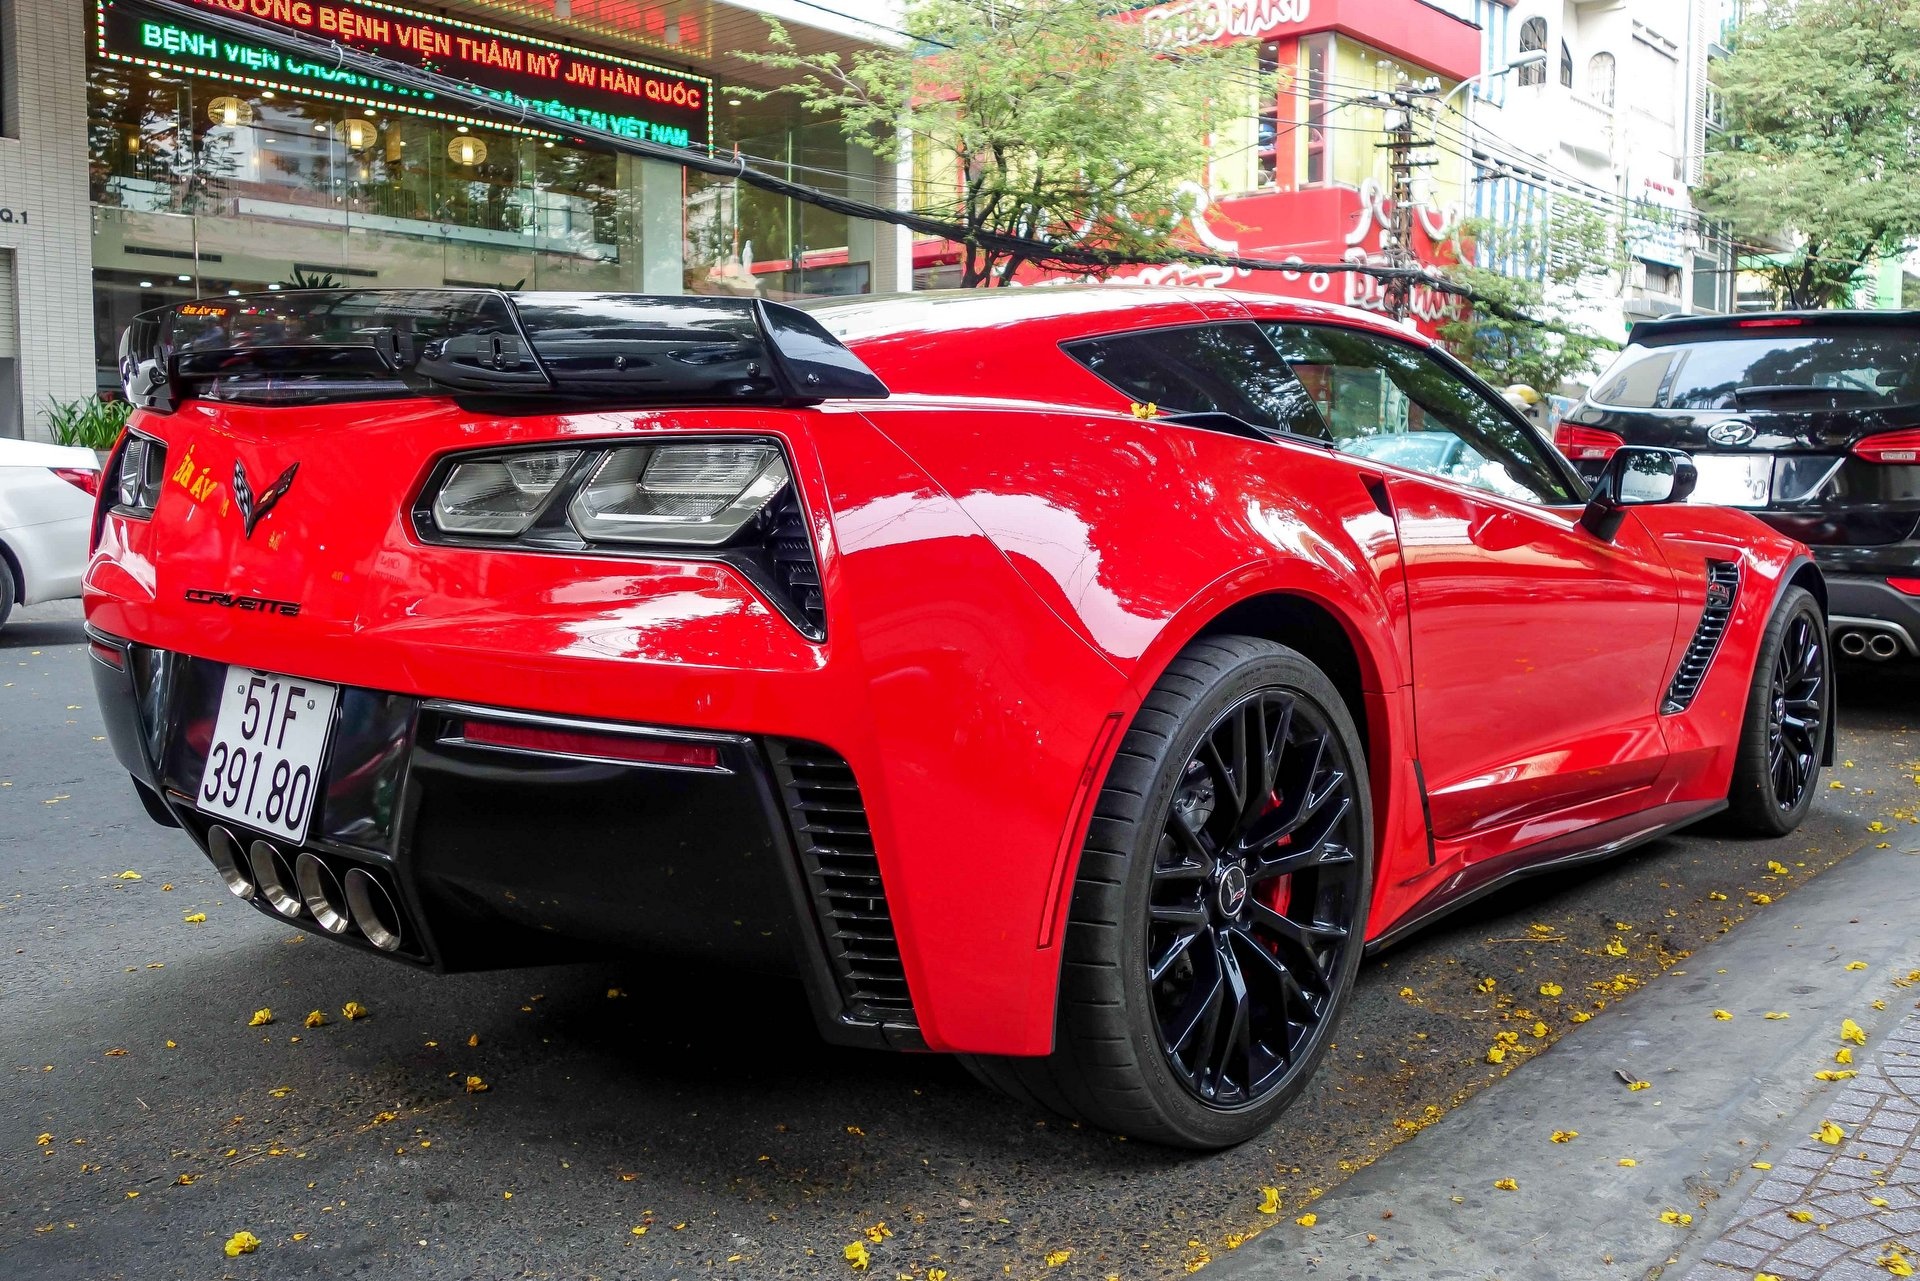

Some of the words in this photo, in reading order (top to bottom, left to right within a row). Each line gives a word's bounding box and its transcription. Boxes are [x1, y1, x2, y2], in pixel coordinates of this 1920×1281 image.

[319, 6, 389, 42] BỆNH
[395, 23, 450, 56] VIỆN
[527, 52, 560, 78] MỸ
[564, 62, 596, 86] JW
[600, 67, 640, 96] HÀN
[645, 81, 700, 108] QUỐC
[651, 123, 689, 147] NAM
[0, 208, 28, 225] Q.1
[185, 588, 302, 616] CORVETTE
[241, 677, 306, 750] 51F
[204, 741, 311, 831] 391.80
